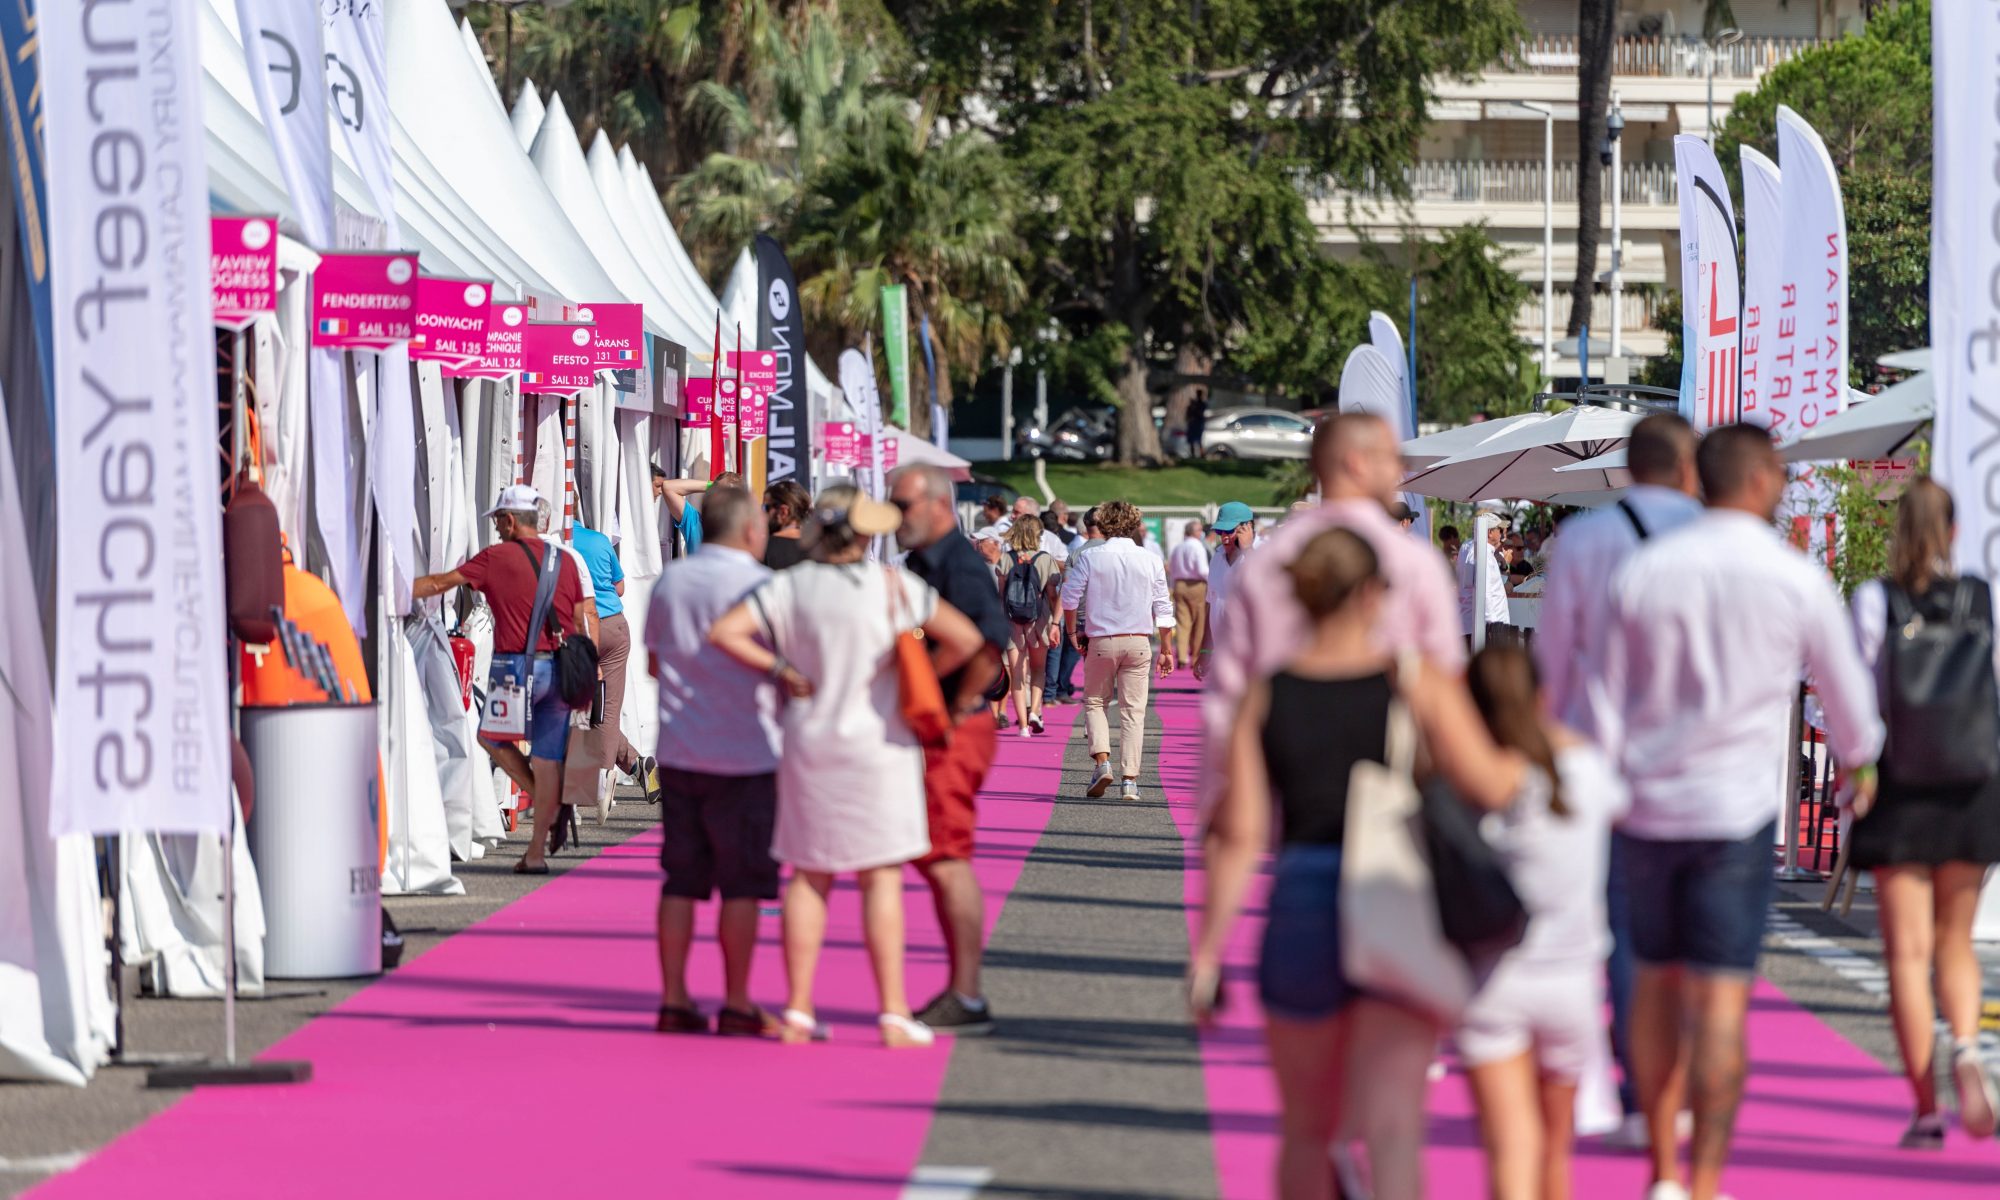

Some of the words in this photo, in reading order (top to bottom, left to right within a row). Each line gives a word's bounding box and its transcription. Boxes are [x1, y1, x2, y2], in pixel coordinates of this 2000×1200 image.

[245, 292, 270, 309] 137
[358, 321, 385, 337] SAIL
[388, 322, 411, 338] 136
[435, 338, 458, 353] SAIL
[462, 341, 481, 355] 135
[552, 355, 590, 366] EFESTO
[596, 352, 611, 361] 131
[480, 357, 500, 368] SAIL
[504, 357, 521, 368] 134
[551, 375, 570, 385] SAIL
[573, 376, 589, 385] 133
[697, 396, 735, 405] CUINS
